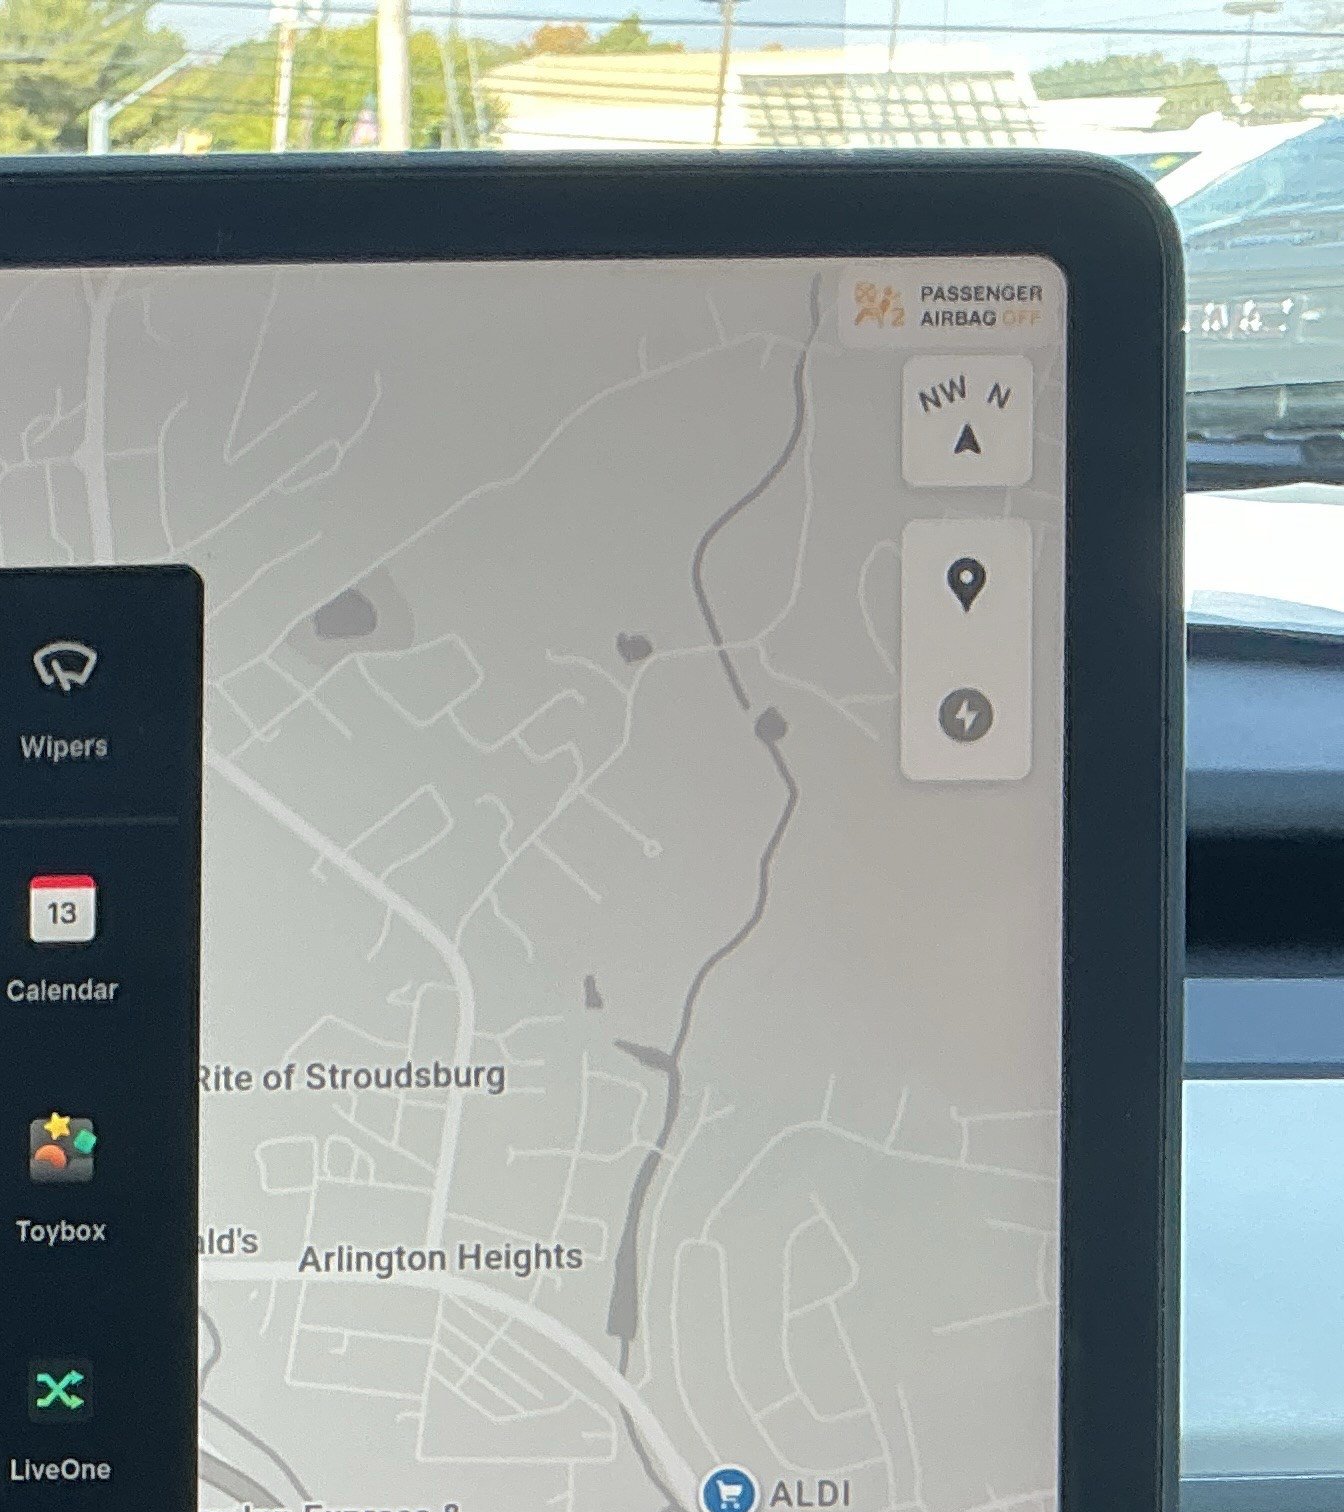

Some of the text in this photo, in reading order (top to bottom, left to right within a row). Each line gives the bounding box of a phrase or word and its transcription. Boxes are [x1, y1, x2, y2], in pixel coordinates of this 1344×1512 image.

[920, 285, 1043, 303] PASSENGER
[920, 310, 1041, 328] AIRBAG OFF
[918, 374, 968, 413] NW
[986, 381, 1012, 409] N
[20, 735, 108, 763] Wipers
[48, 901, 77, 925] 13
[6, 978, 119, 1003] Calendar
[262, 1063, 296, 1091] of
[306, 1060, 505, 1096] Stroudsburg
[15, 1219, 106, 1247] Toybox
[298, 1242, 583, 1280] Arlington Heights
[10, 1458, 112, 1481] LiveOne
[769, 1479, 850, 1508] ALDI
